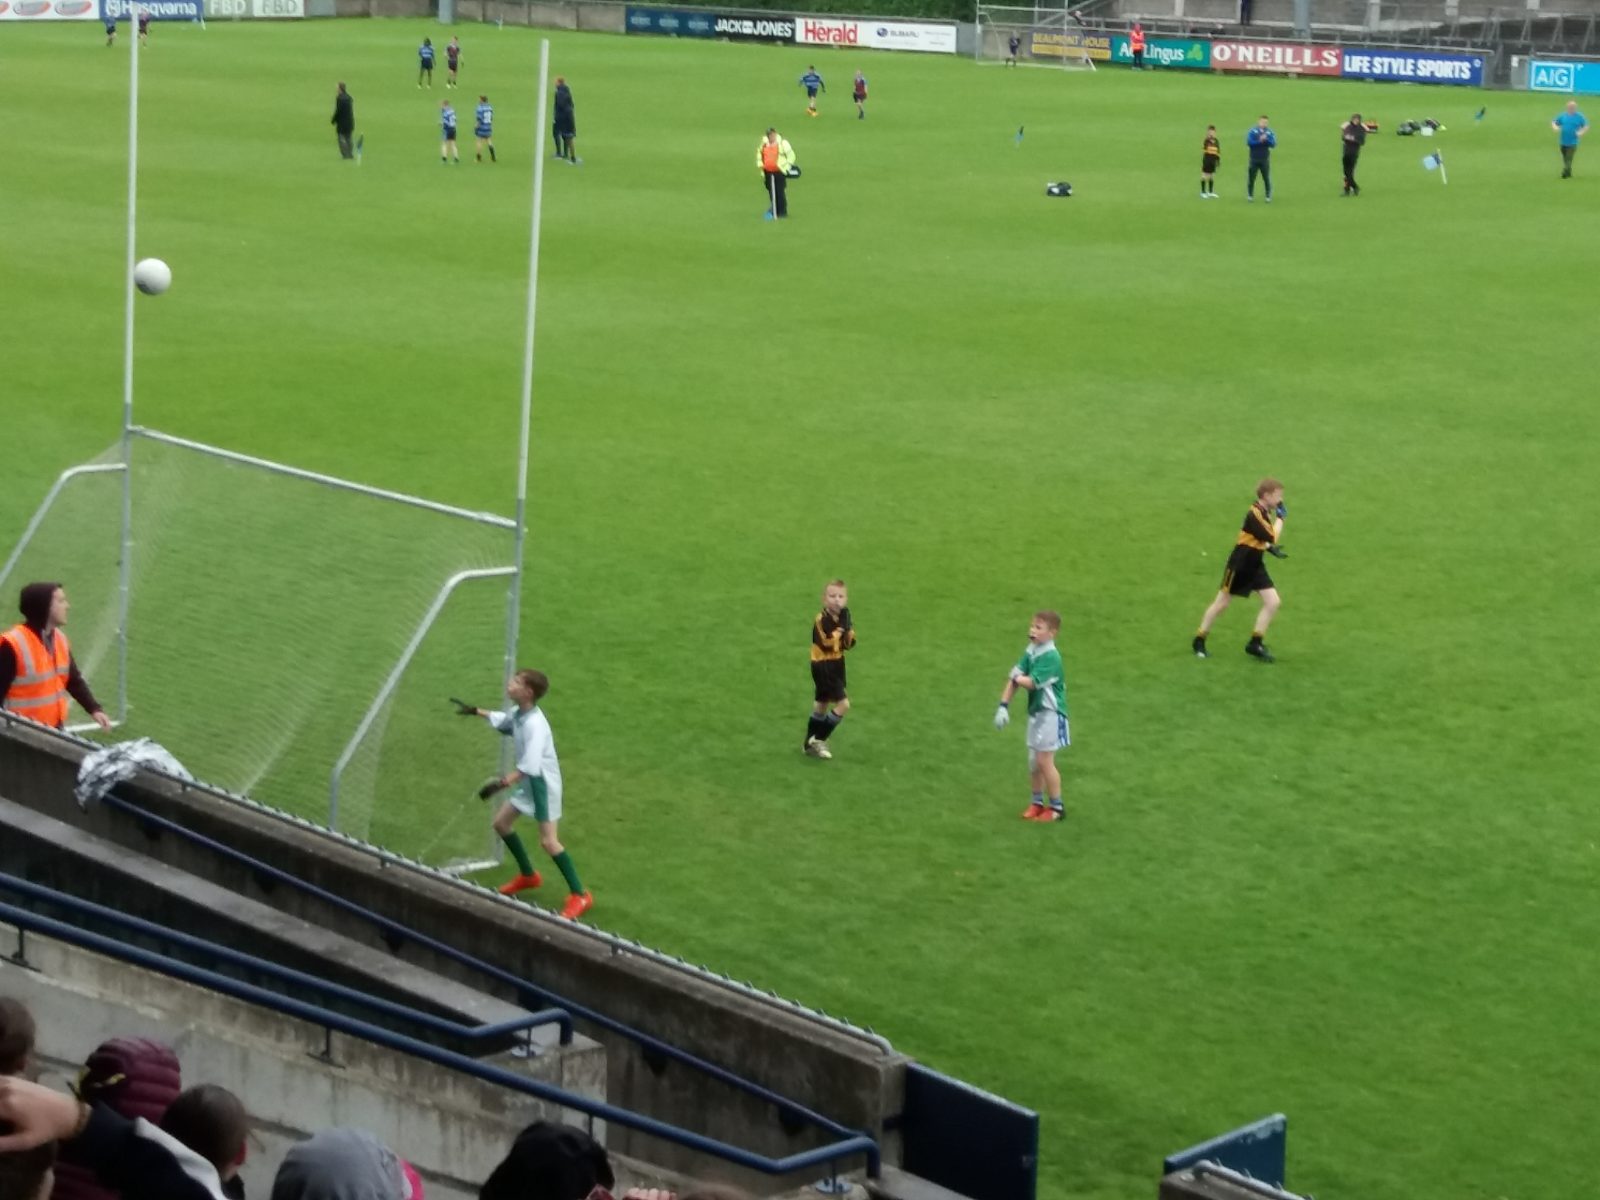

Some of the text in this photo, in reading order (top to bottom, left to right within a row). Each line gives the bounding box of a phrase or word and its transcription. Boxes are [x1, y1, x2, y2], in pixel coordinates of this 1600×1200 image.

[715, 18, 743, 32] JACK
[753, 21, 792, 38] JONES
[804, 21, 858, 44] Herald
[1143, 43, 1185, 65] Lingus
[1212, 44, 1338, 68] O'NEILLS
[1343, 55, 1471, 79] LIFE STYLE SPORTS
[1536, 68, 1569, 86] AIG
